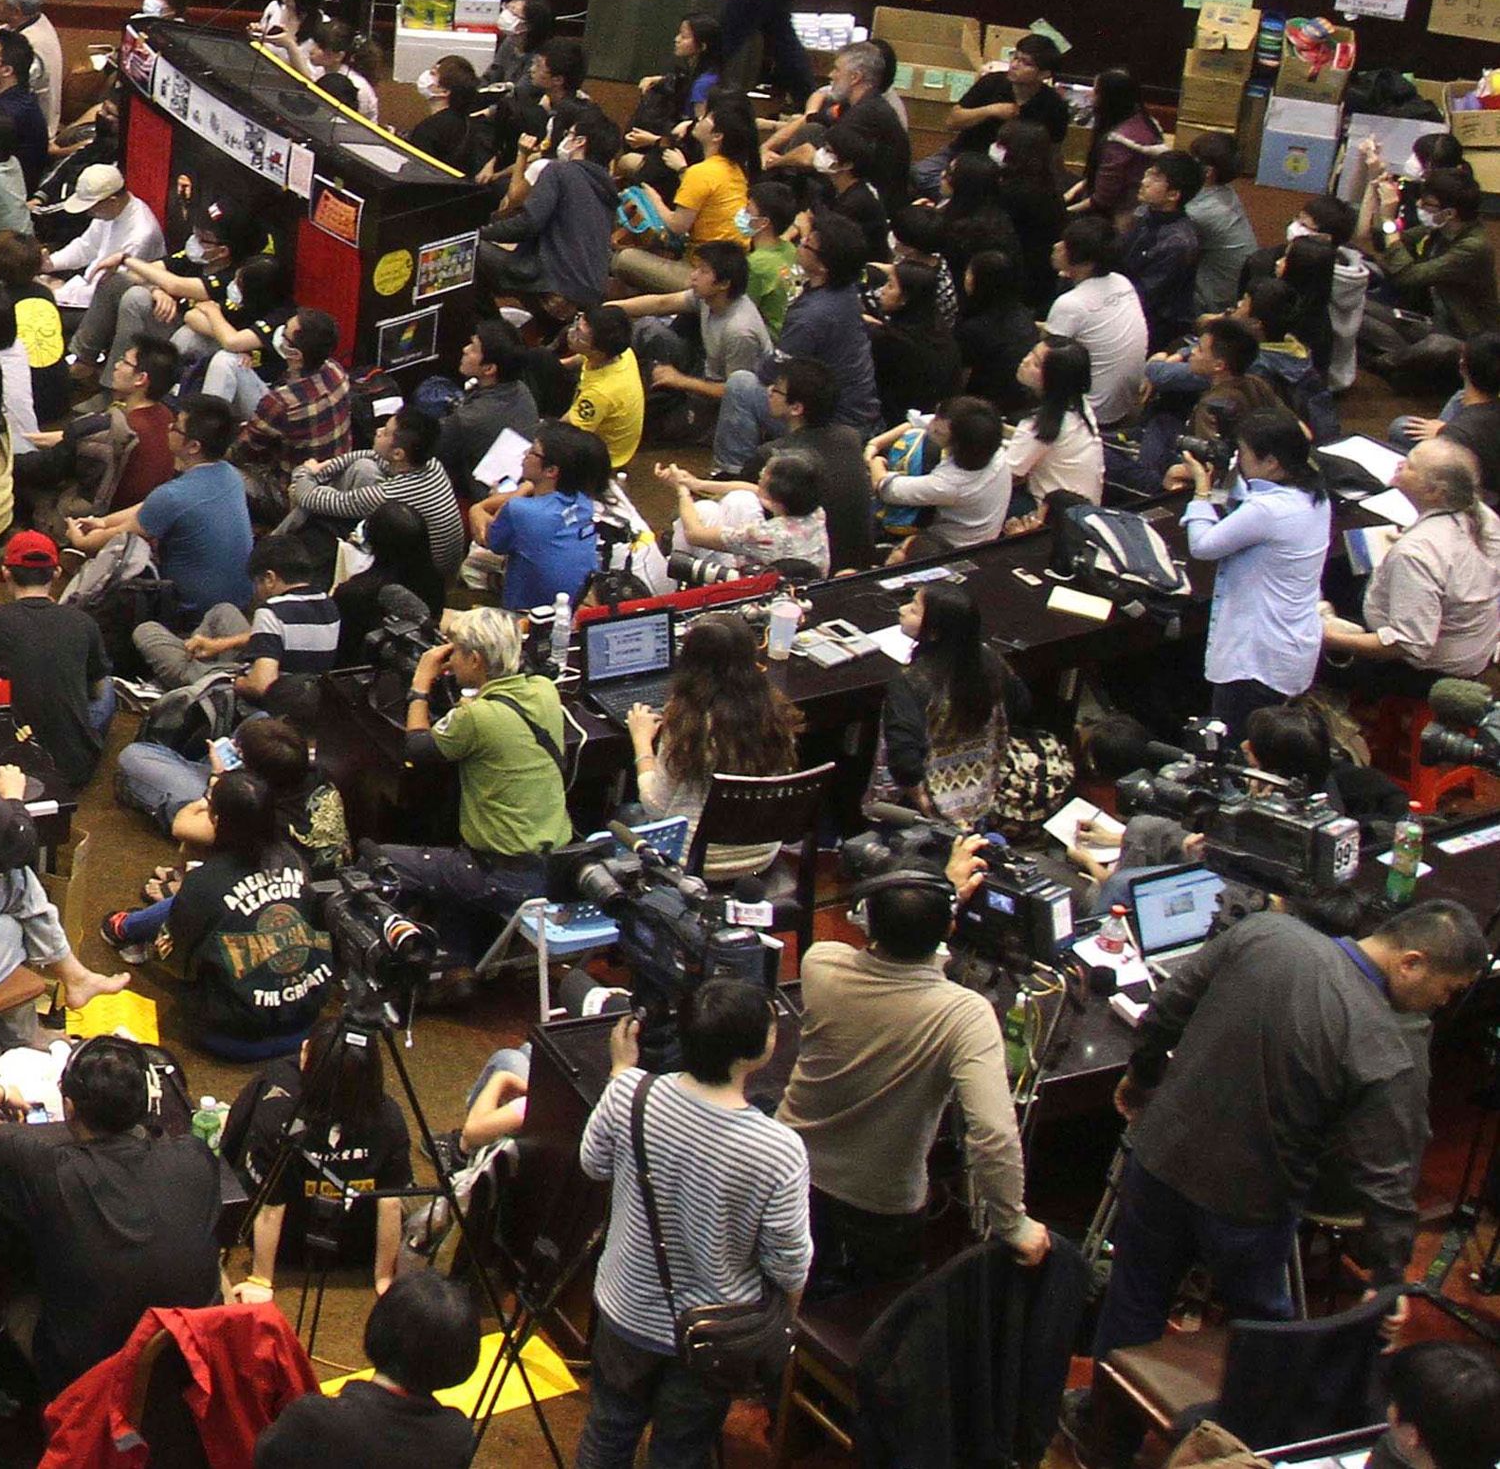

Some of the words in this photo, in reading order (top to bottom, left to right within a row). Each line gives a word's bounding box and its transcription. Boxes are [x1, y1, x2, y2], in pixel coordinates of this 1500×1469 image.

[223, 867, 306, 911] AMERICAN
[237, 878, 301, 917] LEAGUE
[253, 987, 281, 1007] THE
